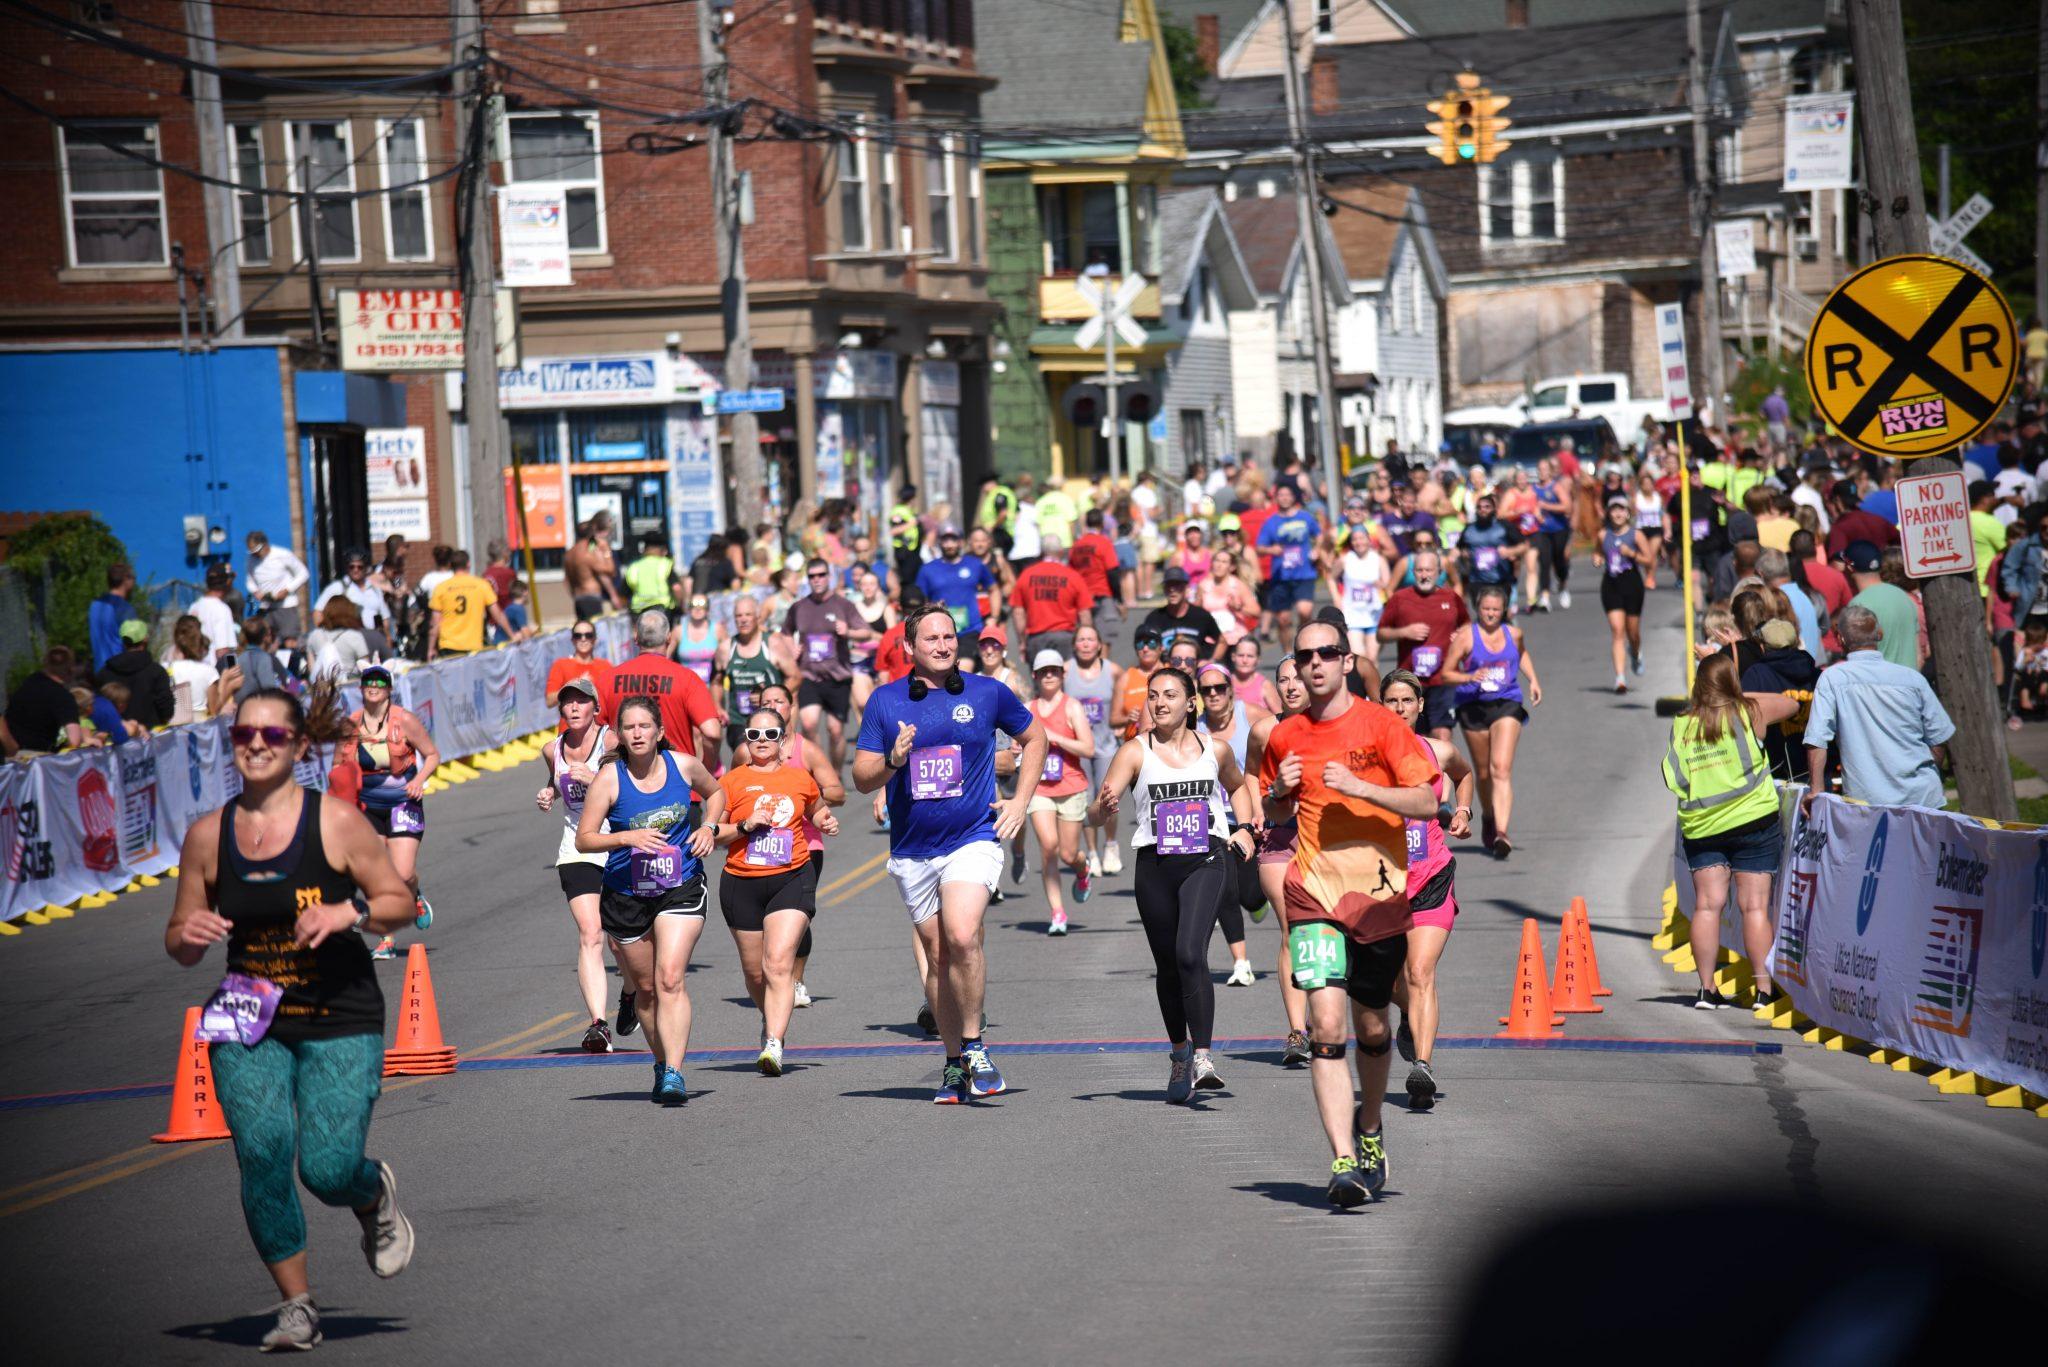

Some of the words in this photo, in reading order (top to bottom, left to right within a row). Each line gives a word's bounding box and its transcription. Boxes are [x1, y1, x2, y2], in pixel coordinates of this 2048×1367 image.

[356, 342, 407, 356] (315)
[1824, 342, 1866, 391] R
[1959, 323, 2003, 372] R
[542, 361, 631, 391] Wireless
[1881, 399, 1944, 423] RUN
[1885, 413, 1945, 436] NYC
[1918, 482, 1944, 502] NO
[1904, 501, 1964, 526] PARKING
[1923, 524, 1949, 539] ANY
[1921, 537, 1955, 554] TIME
[1029, 575, 1068, 589] FINISH
[454, 595, 467, 615] 3
[1034, 588, 1059, 602] LINE
[613, 674, 673, 696] FINISH
[919, 758, 953, 778] 5723
[1154, 781, 1209, 800] ALPHA
[1166, 813, 1200, 833] 8345
[754, 835, 785, 855] 9061
[640, 856, 674, 877] 7499
[1297, 938, 1337, 964] 2144
[1850, 944, 1881, 982] National
[1523, 953, 1533, 1018] FLRRT
[410, 970, 422, 1039] FLRRT
[194, 1042, 208, 1118] FLRRT
